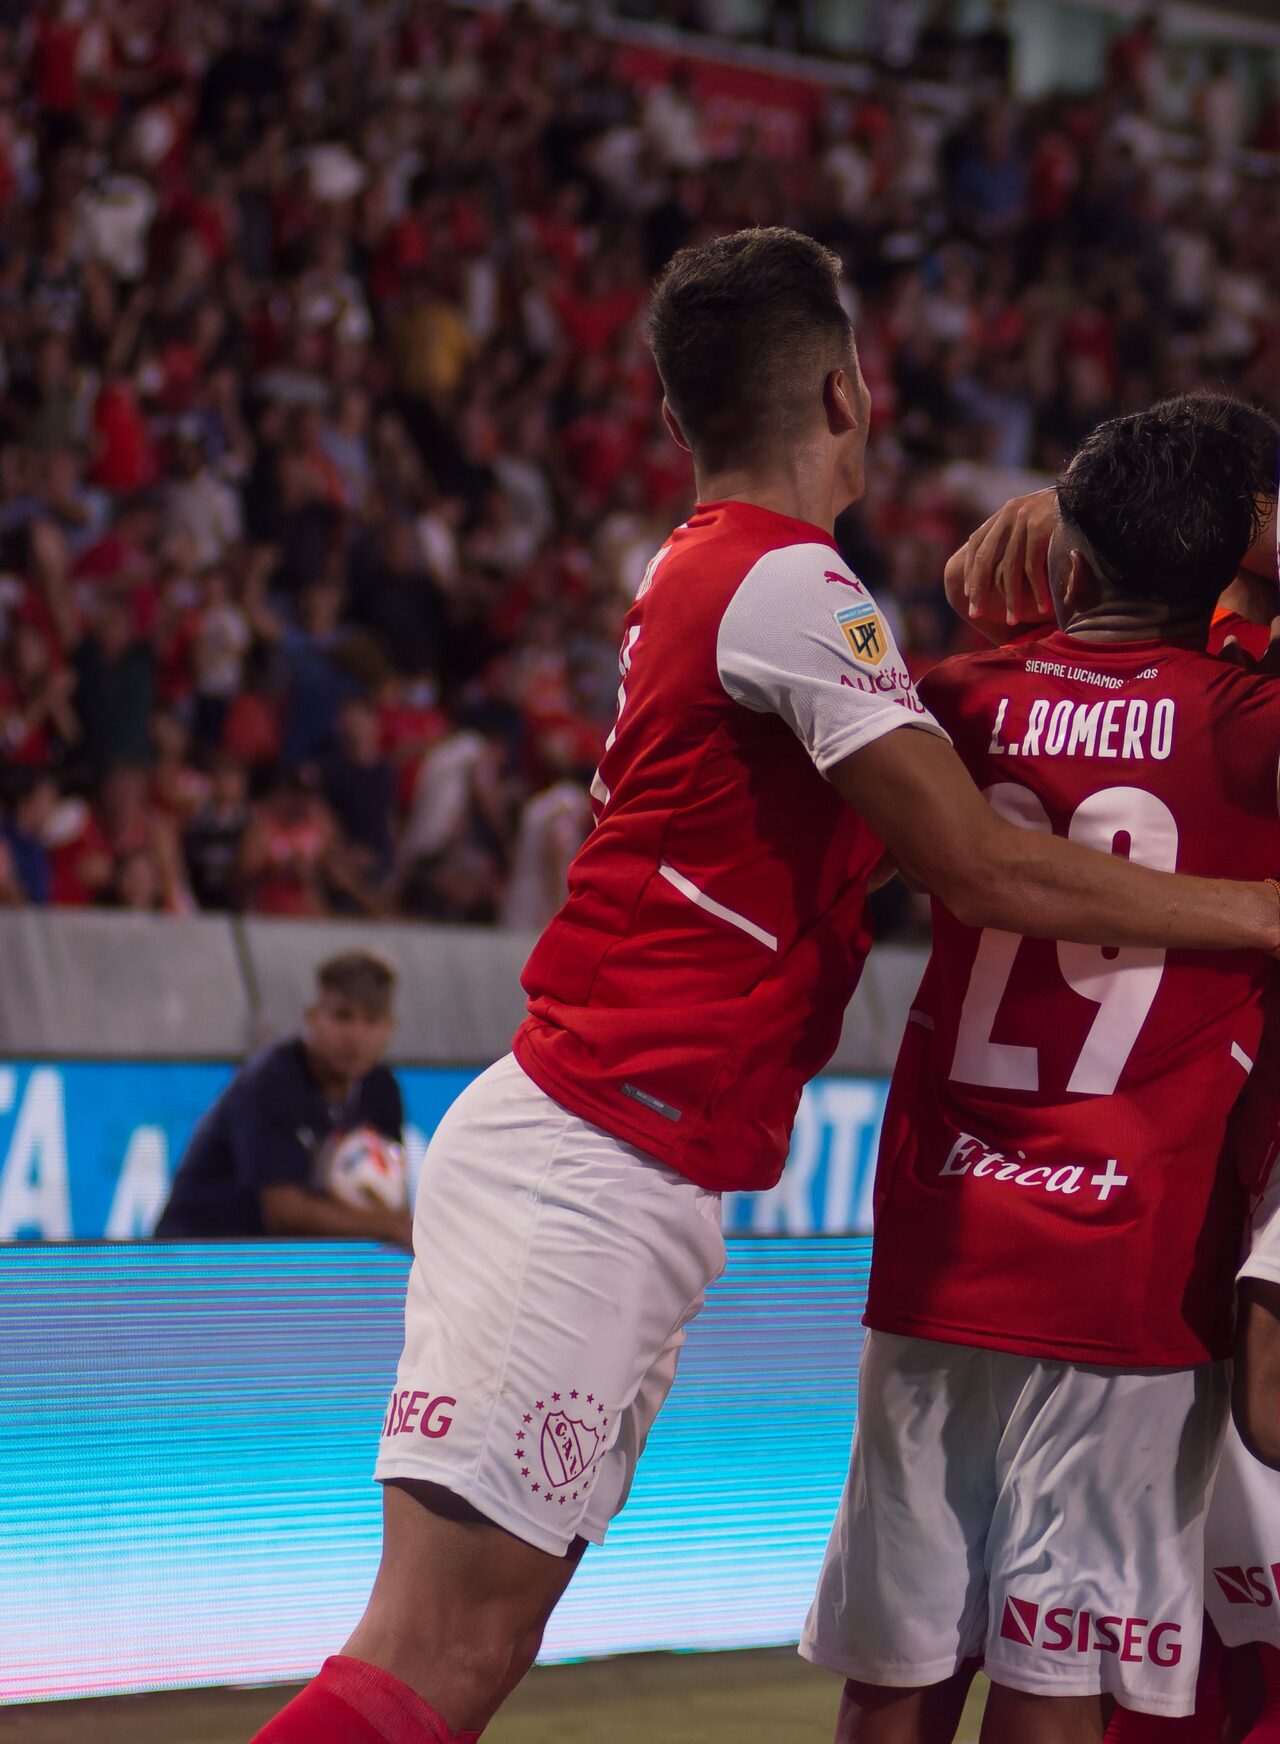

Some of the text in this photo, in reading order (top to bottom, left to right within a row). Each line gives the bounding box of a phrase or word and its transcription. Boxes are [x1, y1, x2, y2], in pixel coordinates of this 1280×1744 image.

[1025, 659, 1067, 679] SIEMPRE
[1067, 666, 1124, 690] LUCHAMOS
[988, 698, 1176, 761] L.ROMERO
[948, 785, 1179, 1096] 29
[939, 1131, 1129, 1202] Etica+
[1042, 1606, 1183, 1668] SISEG
